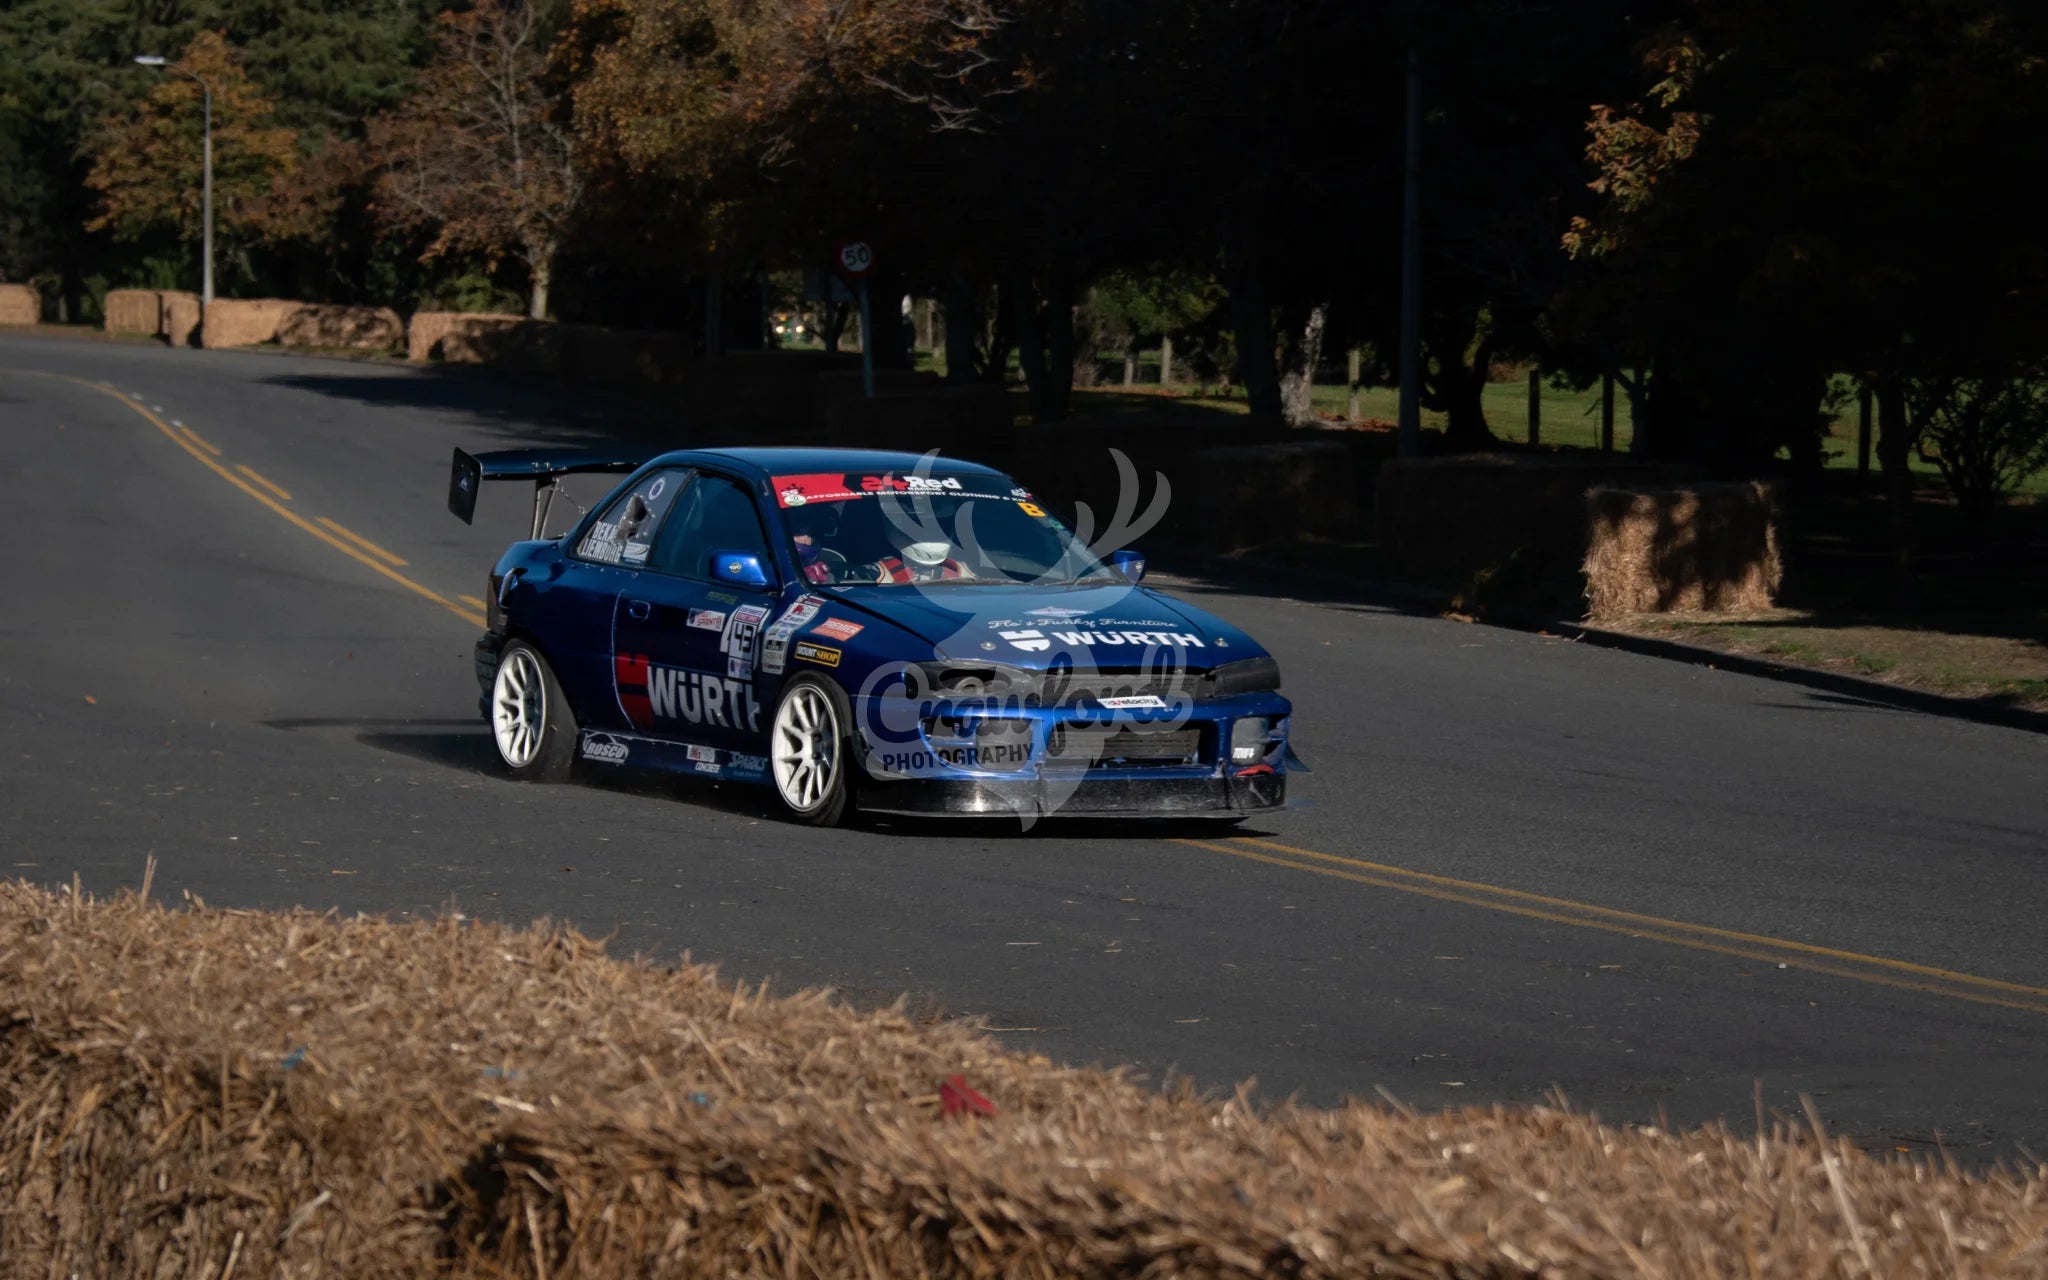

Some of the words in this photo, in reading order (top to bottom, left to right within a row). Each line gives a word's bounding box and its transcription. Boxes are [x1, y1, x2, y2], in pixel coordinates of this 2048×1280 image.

[845, 247, 869, 267] 50
[806, 491, 873, 500] AFFORDABLE
[949, 491, 1000, 500] CLOTHING
[1017, 502, 1046, 517] B
[1037, 618, 1096, 628] Funky
[1099, 618, 1178, 628] Furniture
[1051, 631, 1205, 648] WÜRTH
[585, 742, 626, 759] ROSCO
